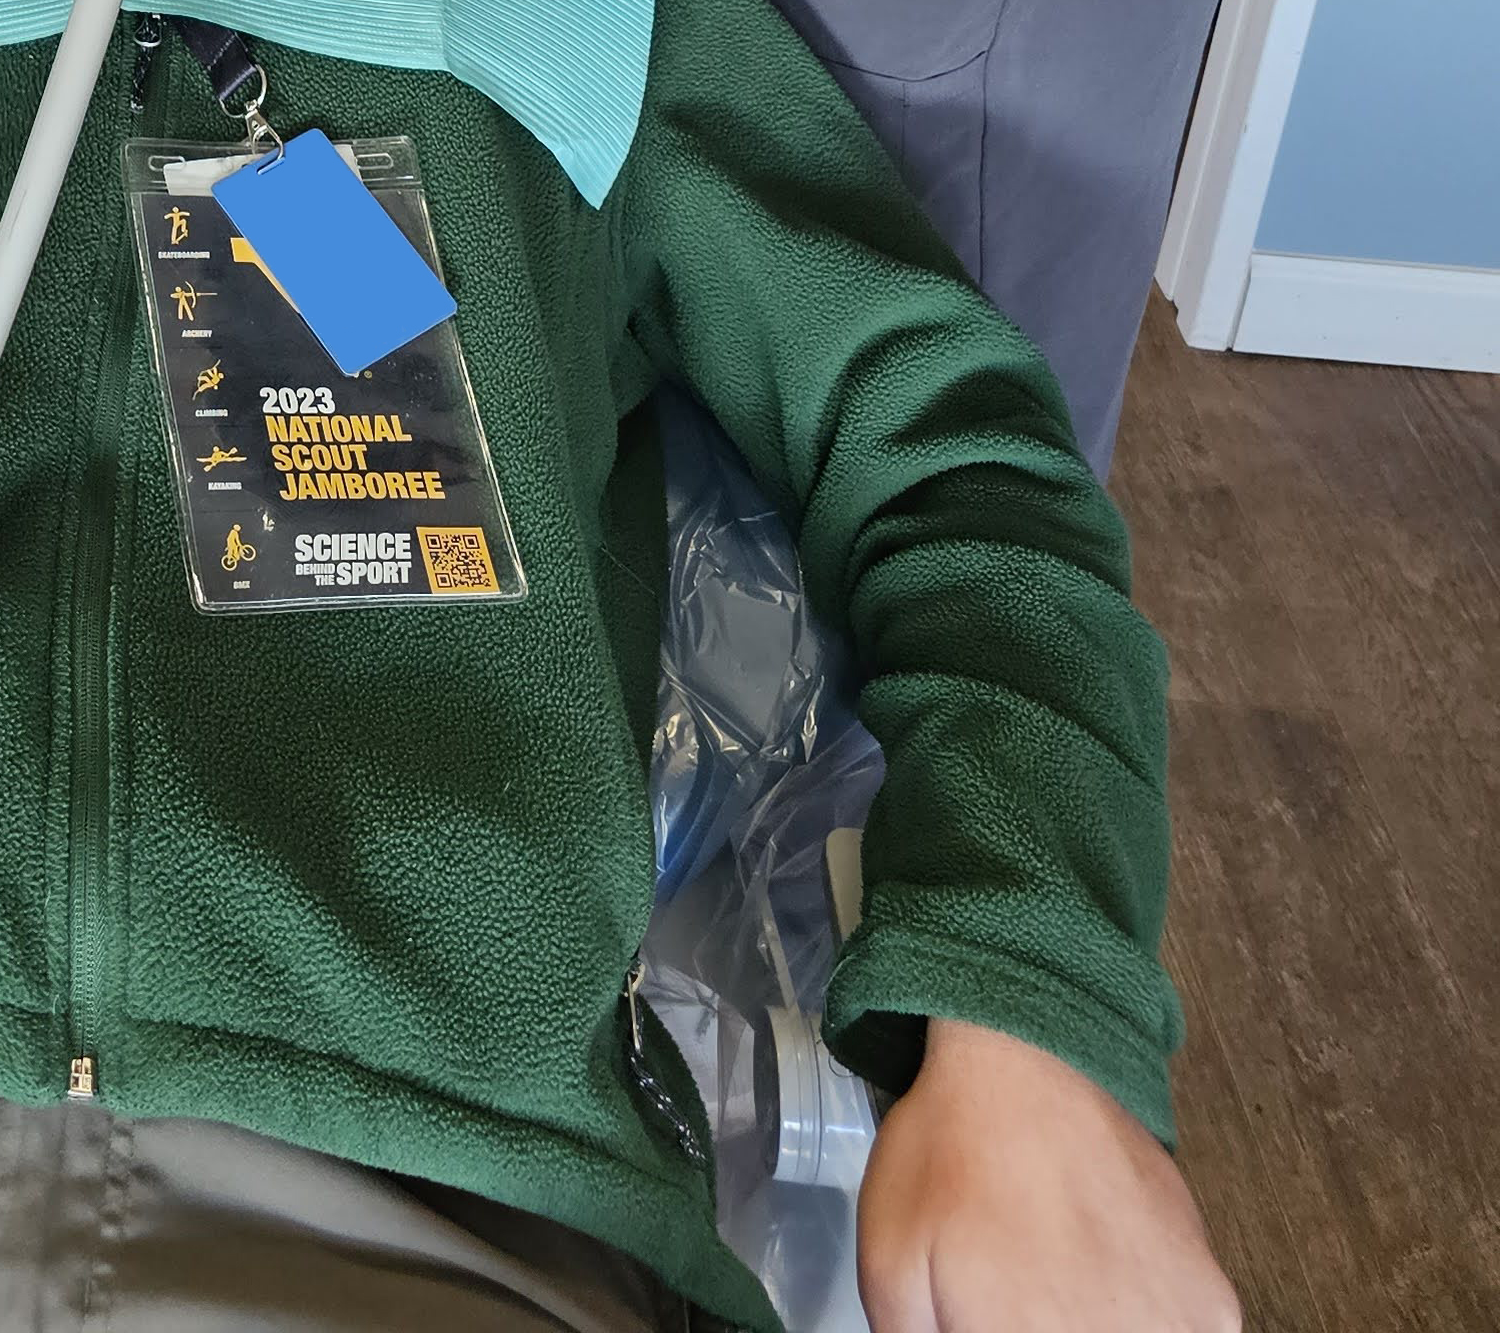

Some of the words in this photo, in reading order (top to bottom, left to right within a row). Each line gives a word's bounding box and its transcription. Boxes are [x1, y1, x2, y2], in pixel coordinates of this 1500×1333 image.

[259, 387, 336, 414] 2023
[265, 415, 412, 442] NATIONAL
[271, 444, 367, 472] SCOUT
[279, 472, 446, 501] JAMBOREE
[294, 533, 412, 562] SCIENCE
[295, 564, 335, 576] BEHIND
[314, 575, 335, 586] THE
[336, 562, 412, 586] SPORT
